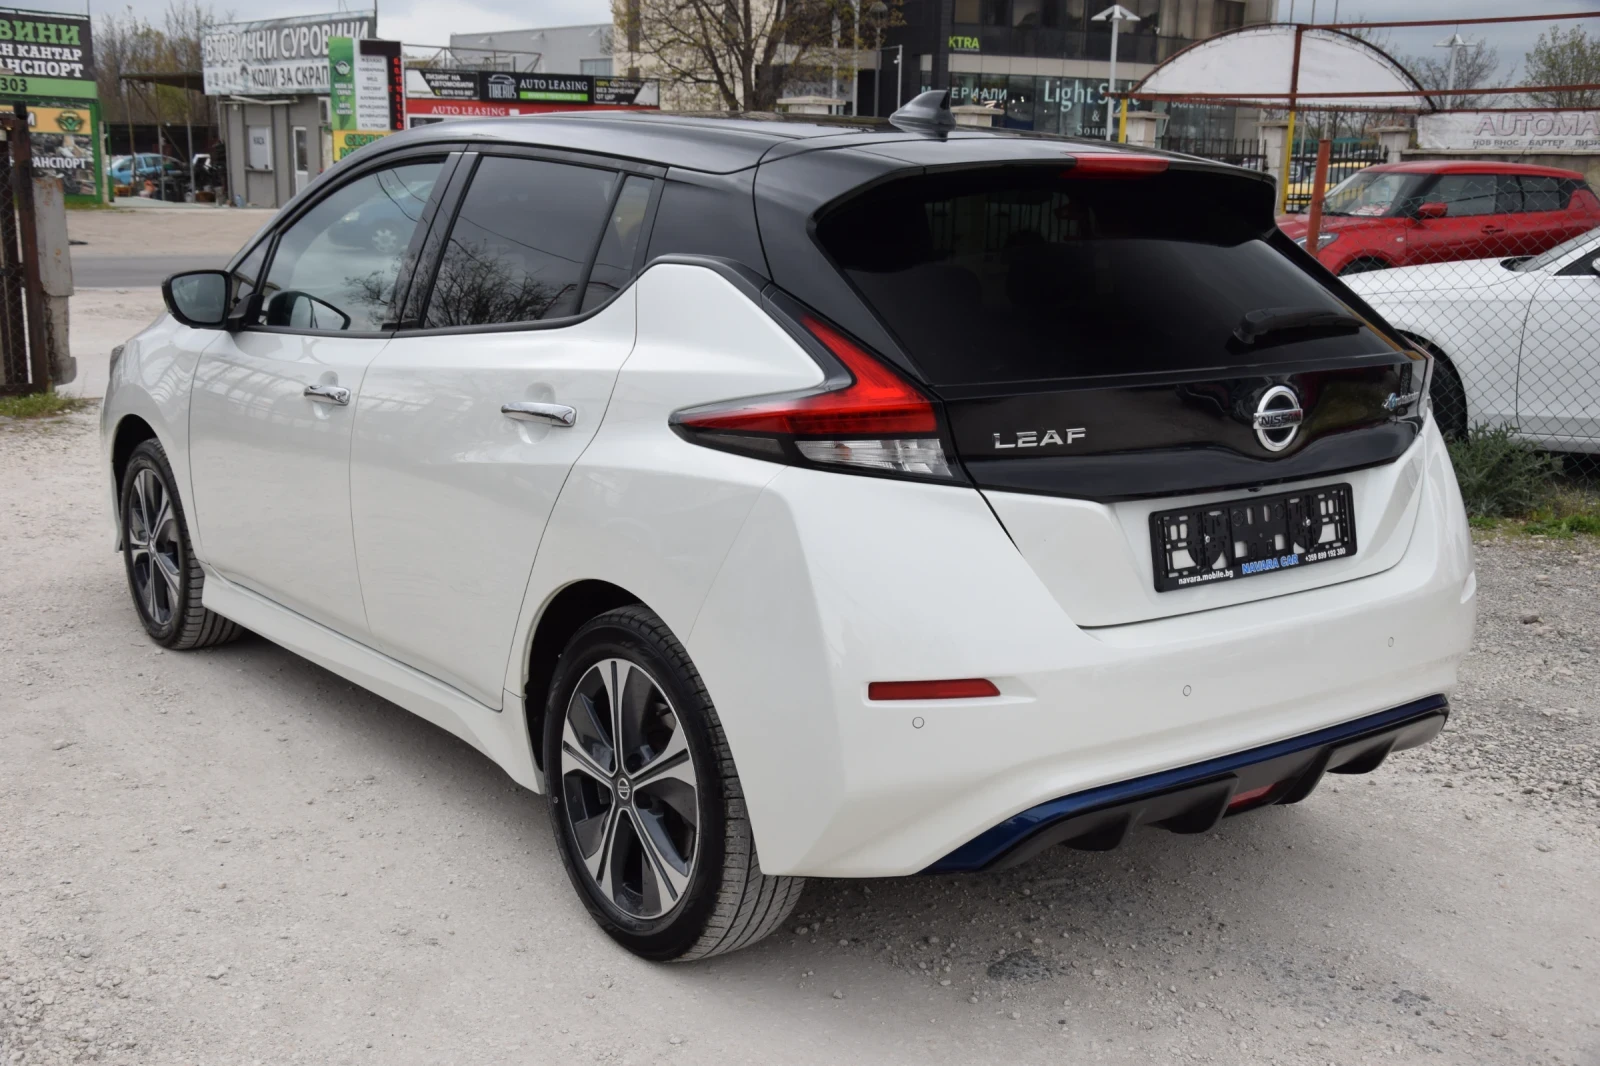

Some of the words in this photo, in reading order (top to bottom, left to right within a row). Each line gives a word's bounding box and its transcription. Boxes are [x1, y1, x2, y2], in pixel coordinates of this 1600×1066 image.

[17, 44, 82, 61] КАНТАР
[206, 29, 277, 62] ВТОРИЧНИ
[252, 67, 278, 87] КОЛИ
[280, 67, 294, 86] ЗА
[295, 65, 330, 86] СКРАП
[520, 79, 546, 89] AUTO
[549, 80, 588, 91] LEASING
[921, 86, 1007, 100] МЕРИАЛИ
[1044, 80, 1096, 112] Light
[432, 105, 460, 114] AUTO
[462, 106, 505, 116] LEASING
[1092, 110, 1101, 122] &
[32, 157, 86, 169] АНСПОРТ
[1259, 411, 1301, 426] NISSAN
[993, 427, 1086, 449] LEAF
[1178, 569, 1234, 585] navara.mobile.bg
[1241, 556, 1278, 574] NAVARA
[1280, 553, 1299, 567] CAR
